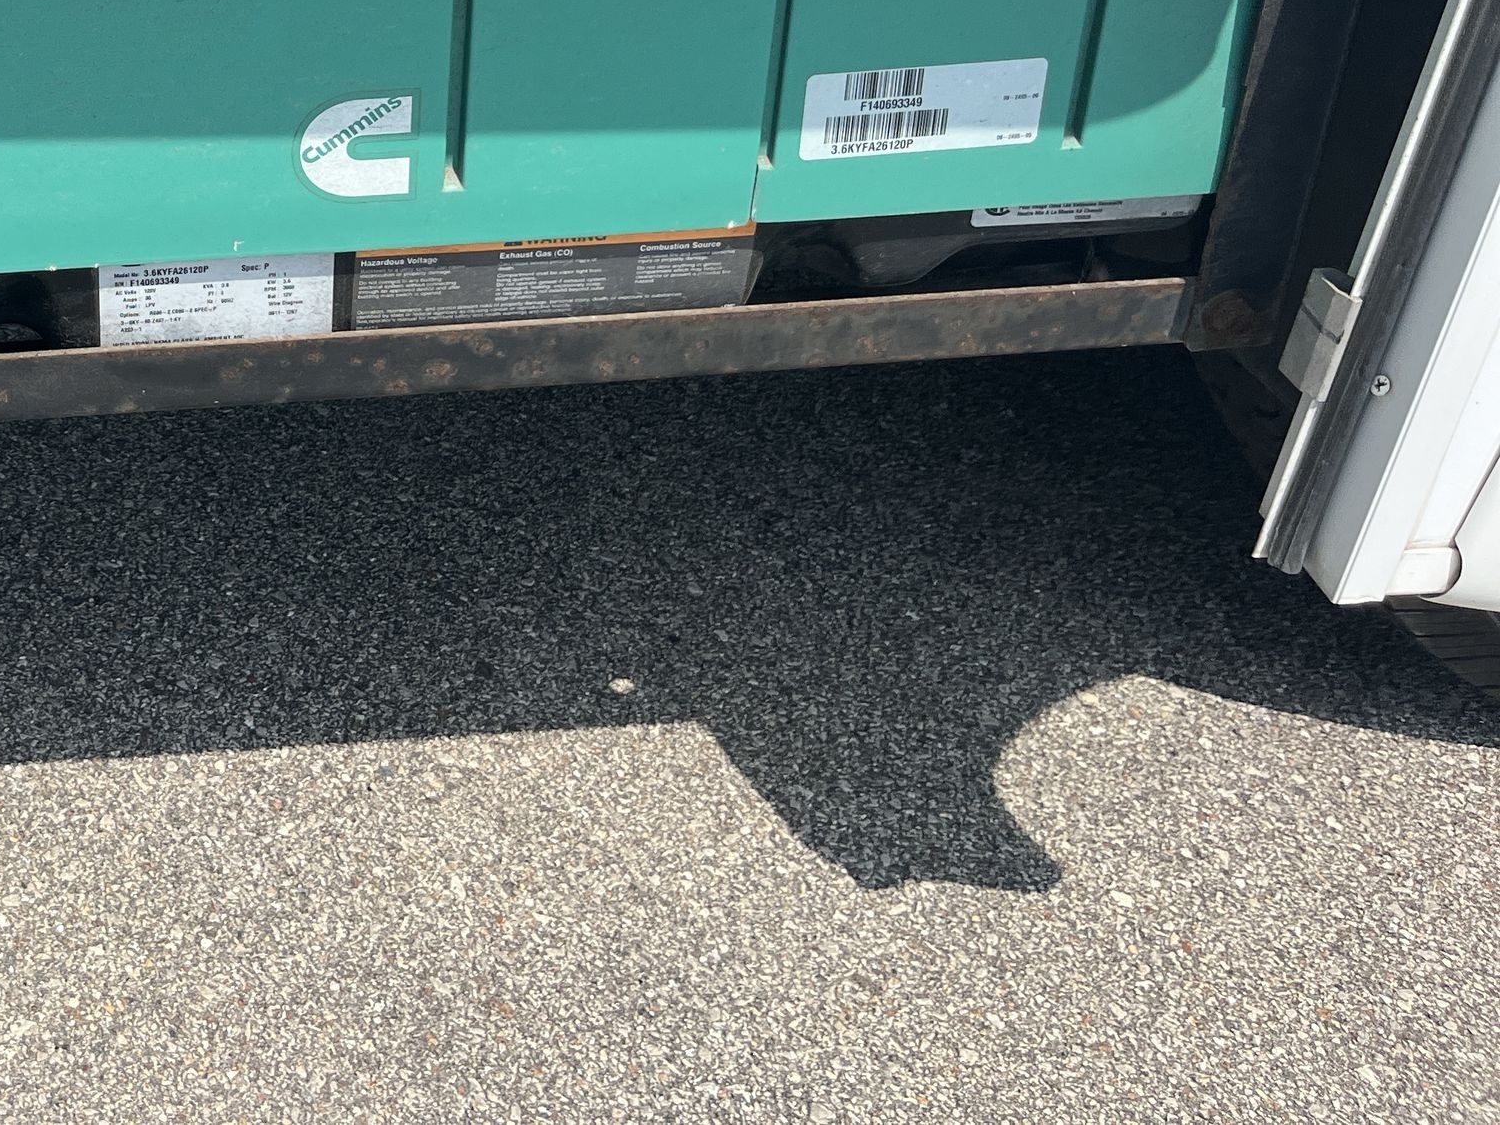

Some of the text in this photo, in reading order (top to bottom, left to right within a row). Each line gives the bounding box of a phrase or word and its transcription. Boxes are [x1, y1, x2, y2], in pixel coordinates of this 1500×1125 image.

[860, 97, 923, 111] F140693349
[301, 96, 403, 164] Cummins
[830, 138, 915, 155] 3.6KYFA26120P
[640, 241, 722, 252] Combustion Source
[499, 249, 574, 259] Exhaust Gas (CO)
[360, 257, 438, 267] Hazardous Voltage
[143, 265, 209, 277] 3.6KYFA26120P
[241, 265, 262, 273] Spec:
[130, 277, 180, 287] F140693349
